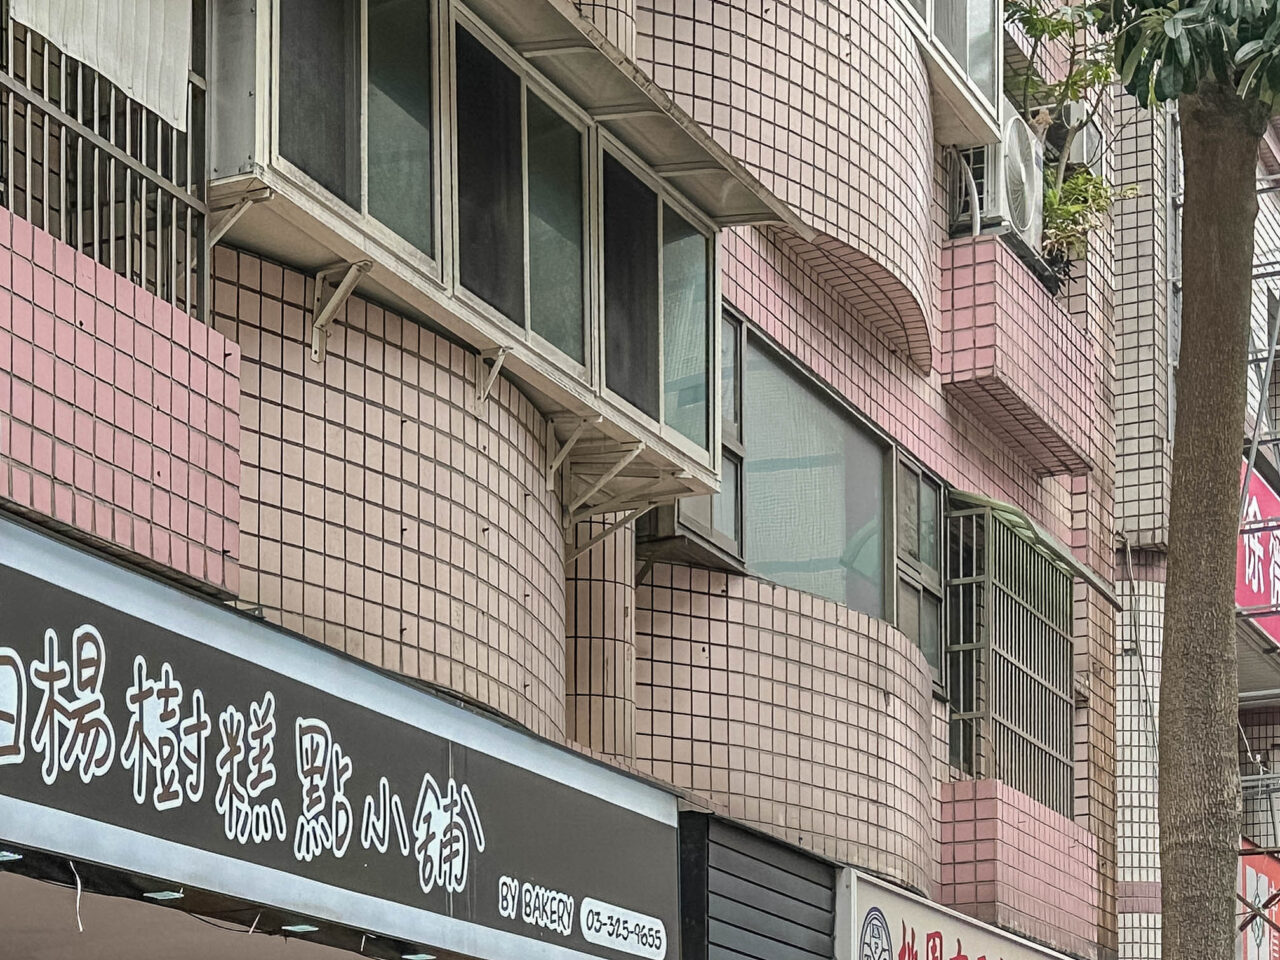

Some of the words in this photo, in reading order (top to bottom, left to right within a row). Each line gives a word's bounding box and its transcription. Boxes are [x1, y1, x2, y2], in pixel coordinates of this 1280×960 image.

[499, 876, 519, 919] BY
[522, 882, 574, 936] BAKERY
[585, 908, 663, 951] 03-325-9655
